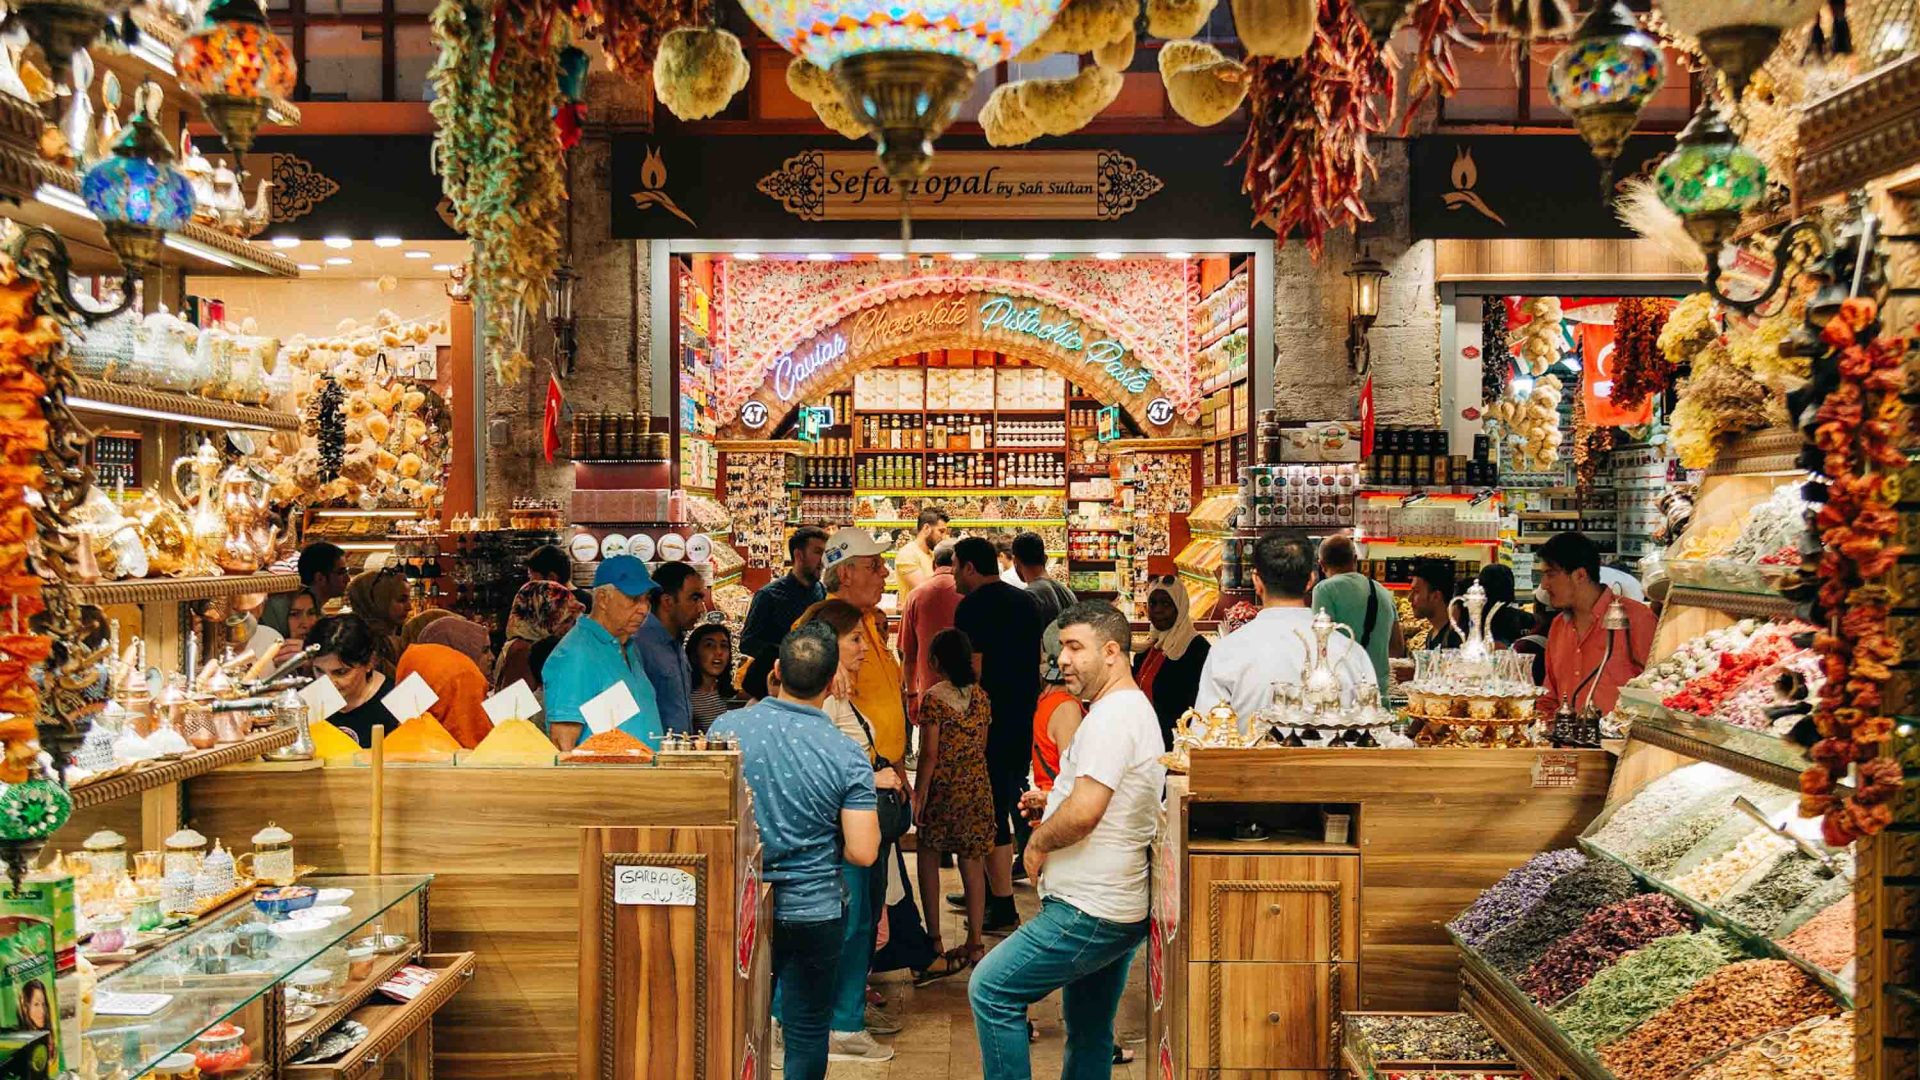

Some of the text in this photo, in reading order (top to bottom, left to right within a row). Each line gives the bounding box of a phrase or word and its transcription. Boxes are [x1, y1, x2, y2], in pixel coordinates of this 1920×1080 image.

[826, 166, 893, 203] Sefa
[996, 181, 1013, 199] by
[1048, 181, 1093, 195] Sultan
[776, 295, 1152, 400] Caviar Chocolate Pistachio Paste
[745, 406, 764, 422] 47
[1150, 403, 1169, 419] 47
